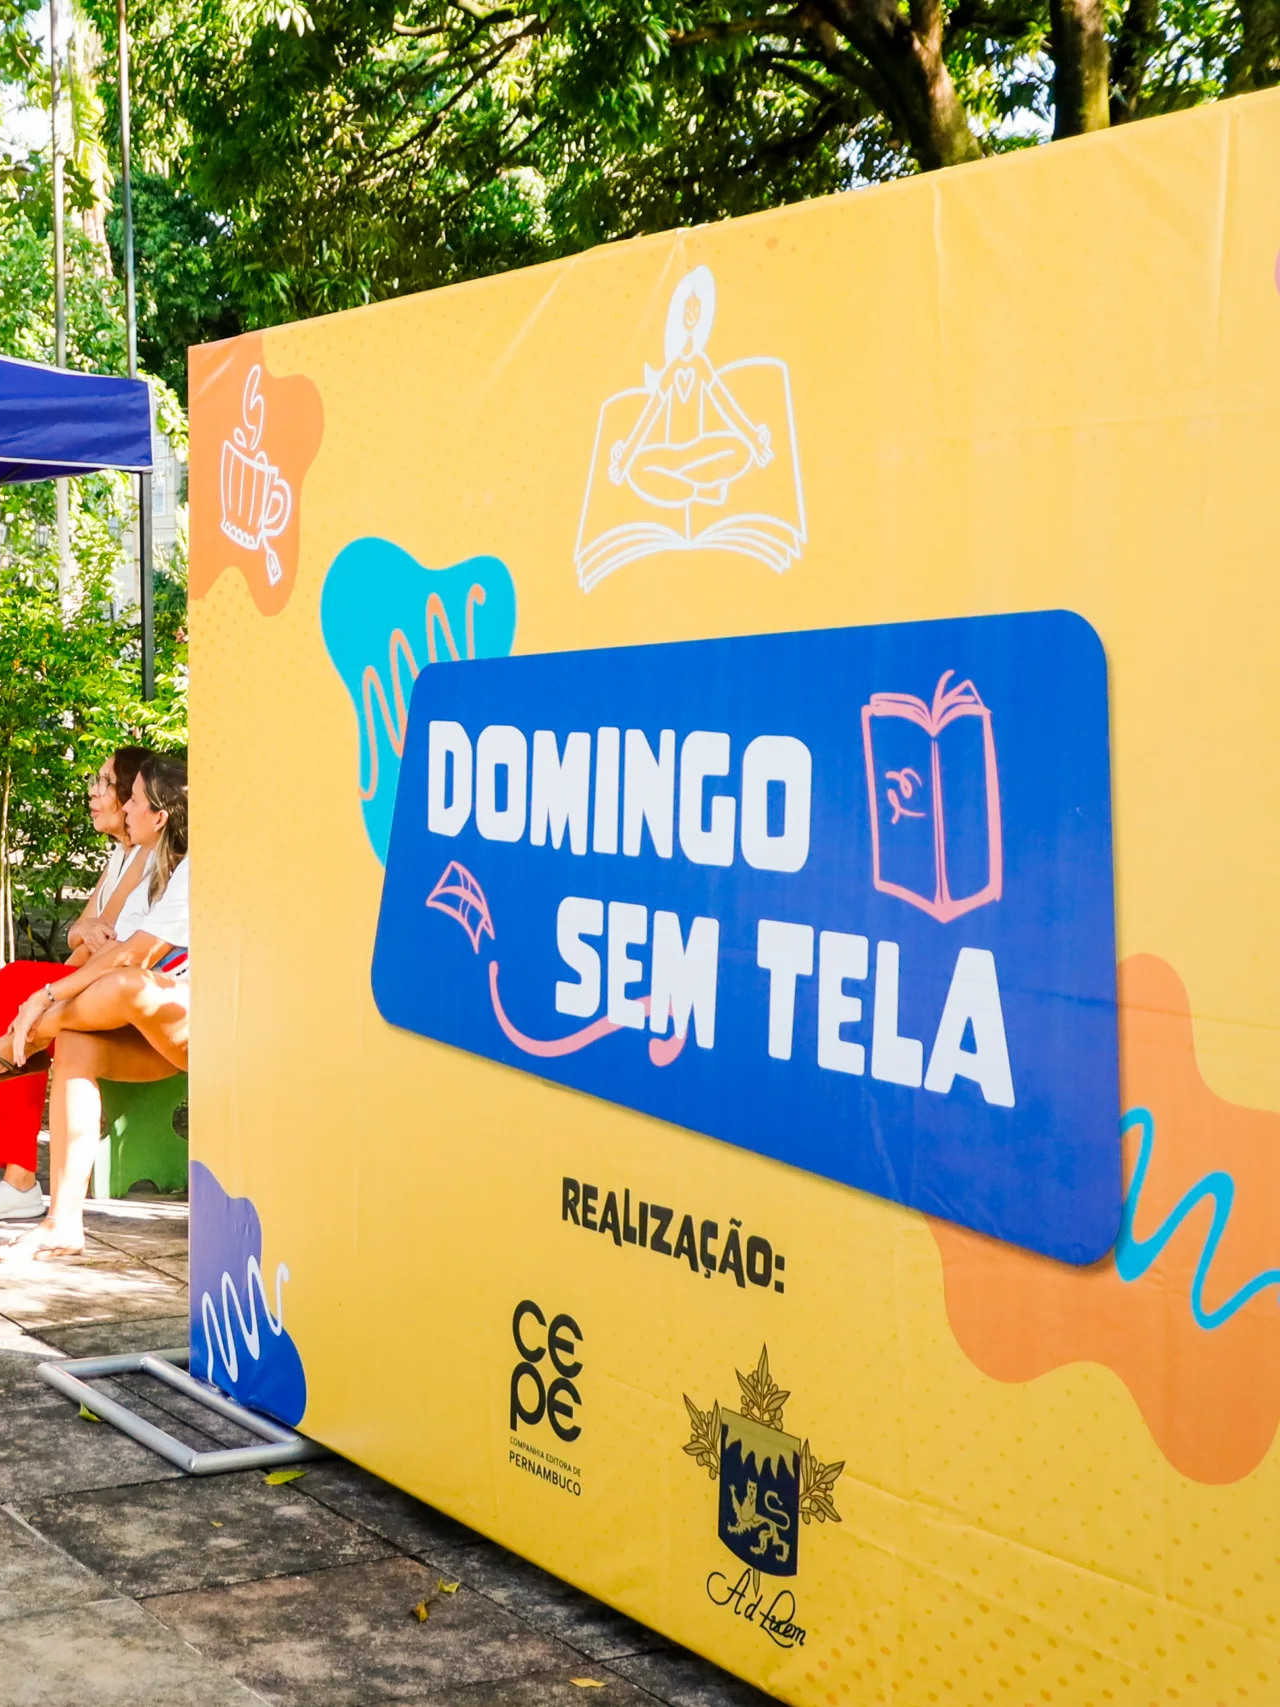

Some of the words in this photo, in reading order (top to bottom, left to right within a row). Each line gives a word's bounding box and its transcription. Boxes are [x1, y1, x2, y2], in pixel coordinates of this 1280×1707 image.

[427, 720, 812, 873] DOMINGO
[554, 895, 719, 1050] SEM
[757, 918, 1016, 1108] TELA
[562, 1176, 785, 1294] REALIZAÇÃO:
[509, 1436, 545, 1459] COMPANHIA
[545, 1452, 572, 1473] EDITORA
[572, 1466, 582, 1478] DE
[509, 1449, 582, 1497] PERNAMBUCO
[706, 1567, 763, 1621] Ad
